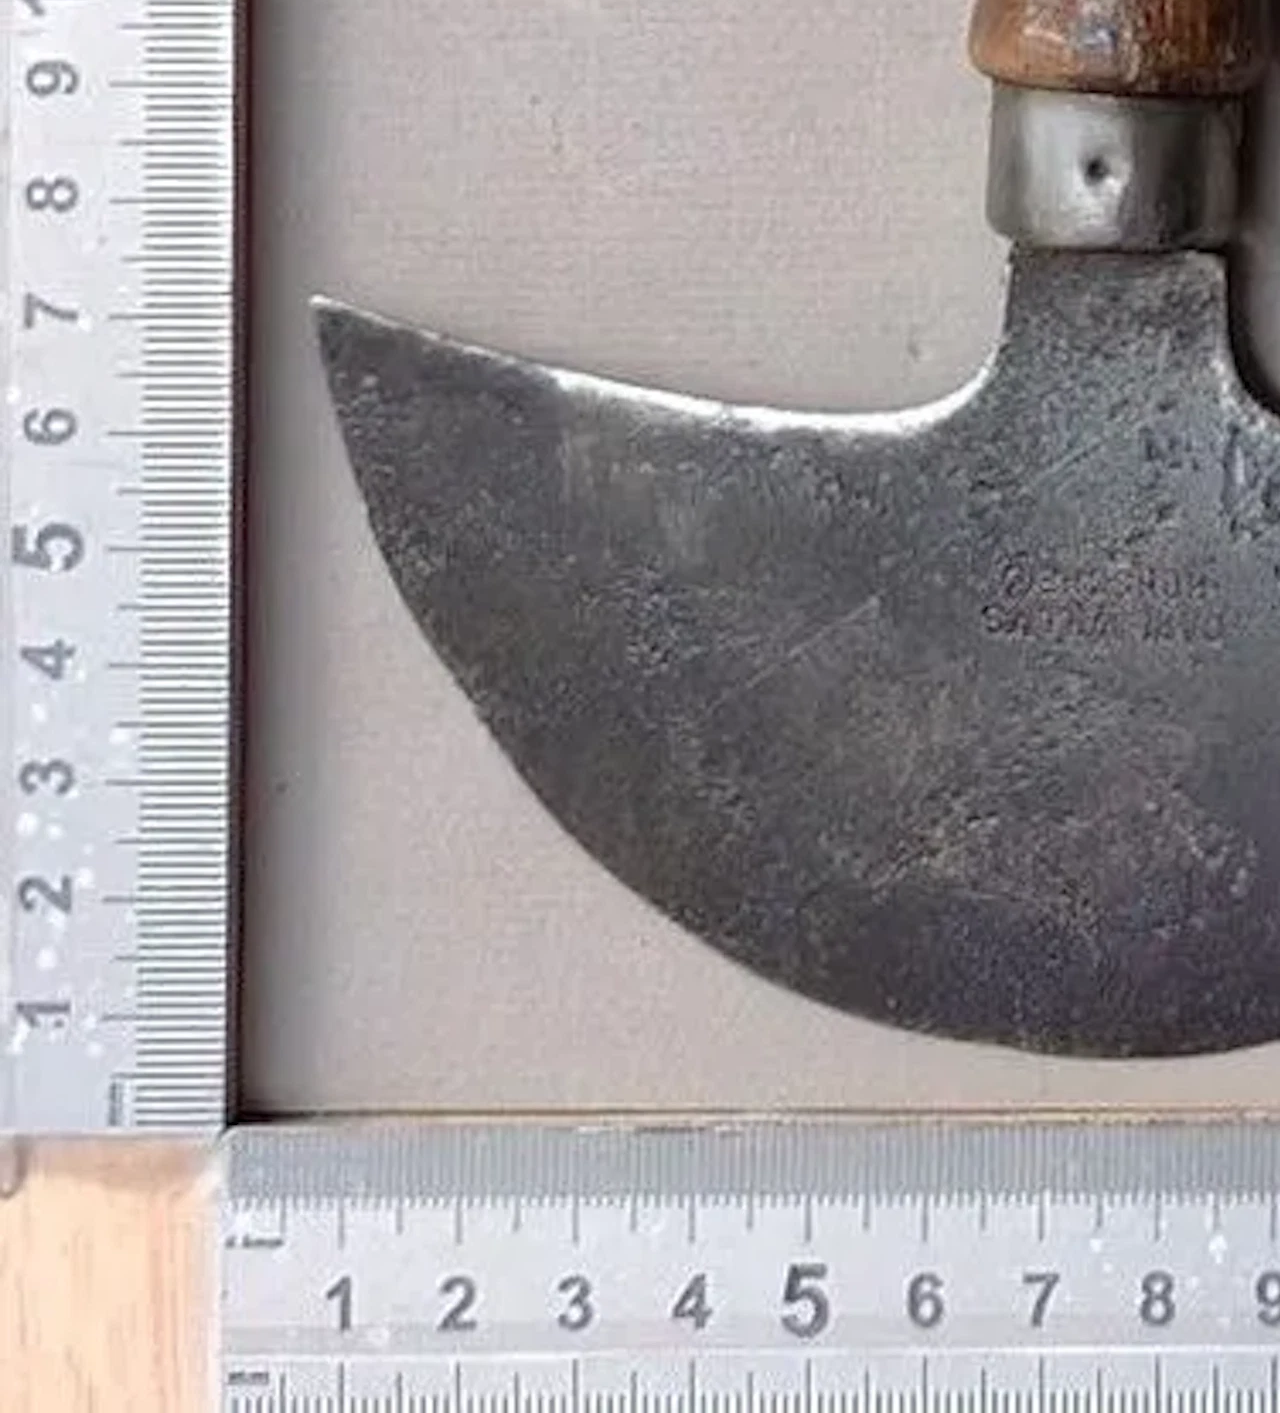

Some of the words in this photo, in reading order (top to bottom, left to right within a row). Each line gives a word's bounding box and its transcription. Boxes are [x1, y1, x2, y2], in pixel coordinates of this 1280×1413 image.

[25, 60, 80, 98] 9
[24, 177, 79, 214] 8
[23, 292, 79, 330] 7
[22, 408, 78, 446] 6
[11, 523, 84, 572] 5
[19, 639, 76, 681] 4
[18, 759, 76, 796] 3
[15, 875, 73, 915] 2
[12, 1000, 71, 1028] 1
[325, 1276, 352, 1335] 1
[437, 1276, 477, 1333] 2
[557, 1275, 593, 1332] 3
[672, 1273, 712, 1330] 4
[781, 1264, 829, 1338] 5
[907, 1273, 944, 1330] 6
[1022, 1272, 1060, 1329] 7
[1140, 1271, 1175, 1327] 8
